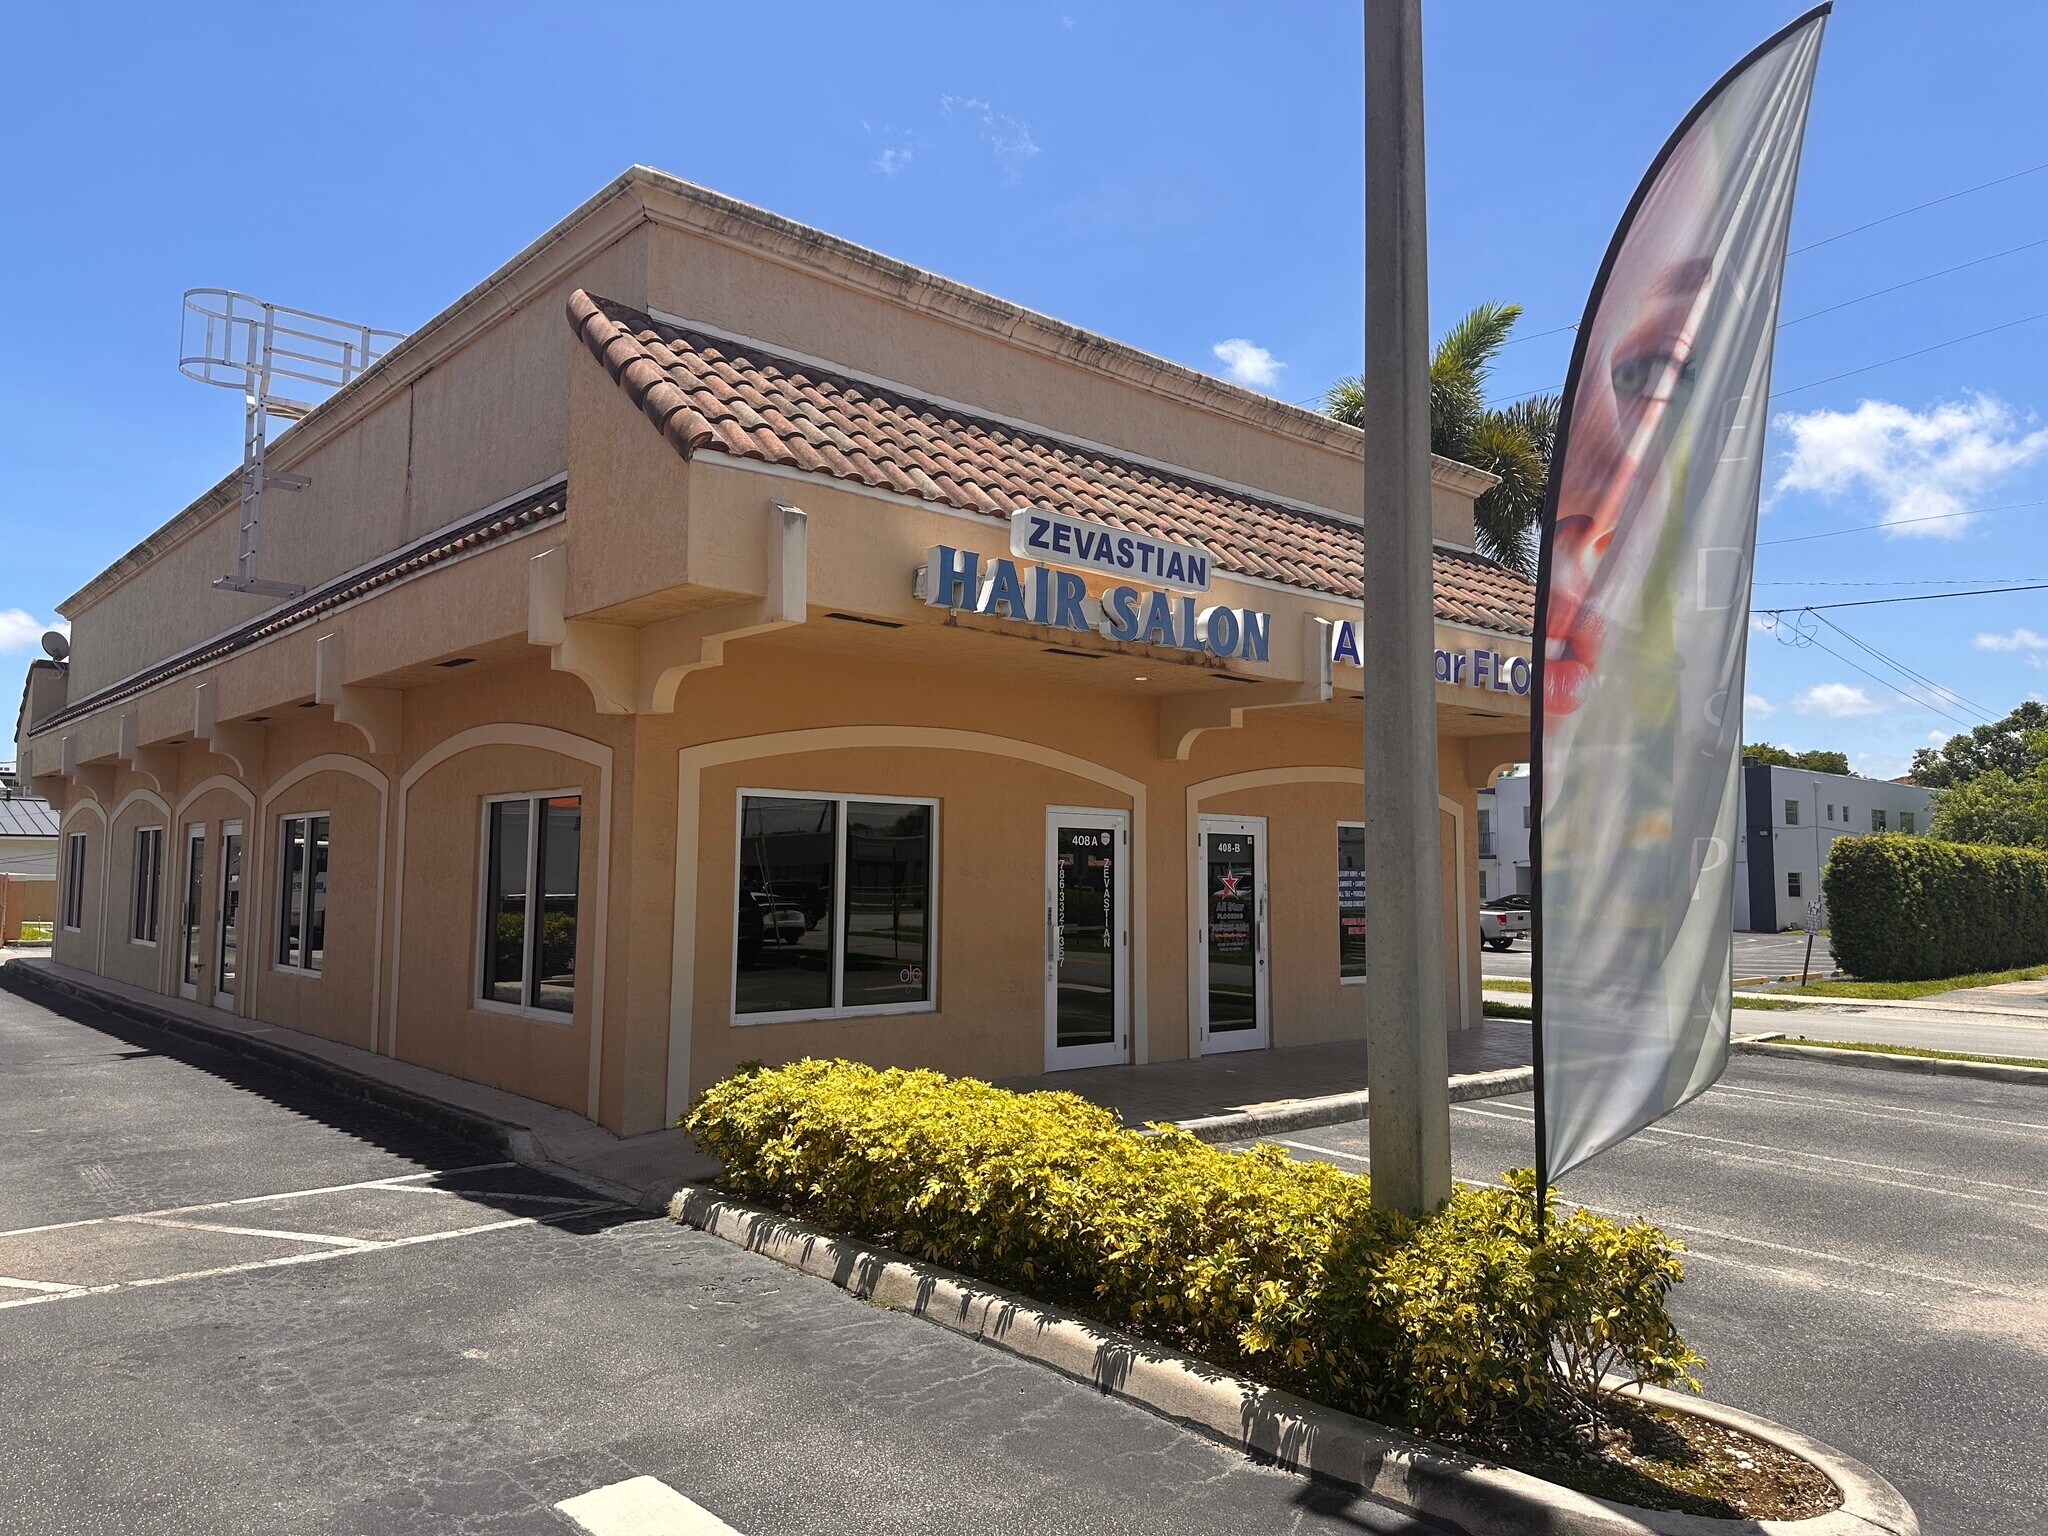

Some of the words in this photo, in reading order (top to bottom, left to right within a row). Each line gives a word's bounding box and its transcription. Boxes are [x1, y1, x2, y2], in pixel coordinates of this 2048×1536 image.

[1028, 516, 1206, 587] ZEVASTIAN
[930, 544, 1090, 632] HAIR
[1106, 585, 1271, 662] SALON
[1434, 649, 1467, 685] ar
[1473, 649, 1532, 696] FLO
[1217, 843, 1241, 853] 408-B
[1103, 858, 1111, 948] ZEVASTIAN
